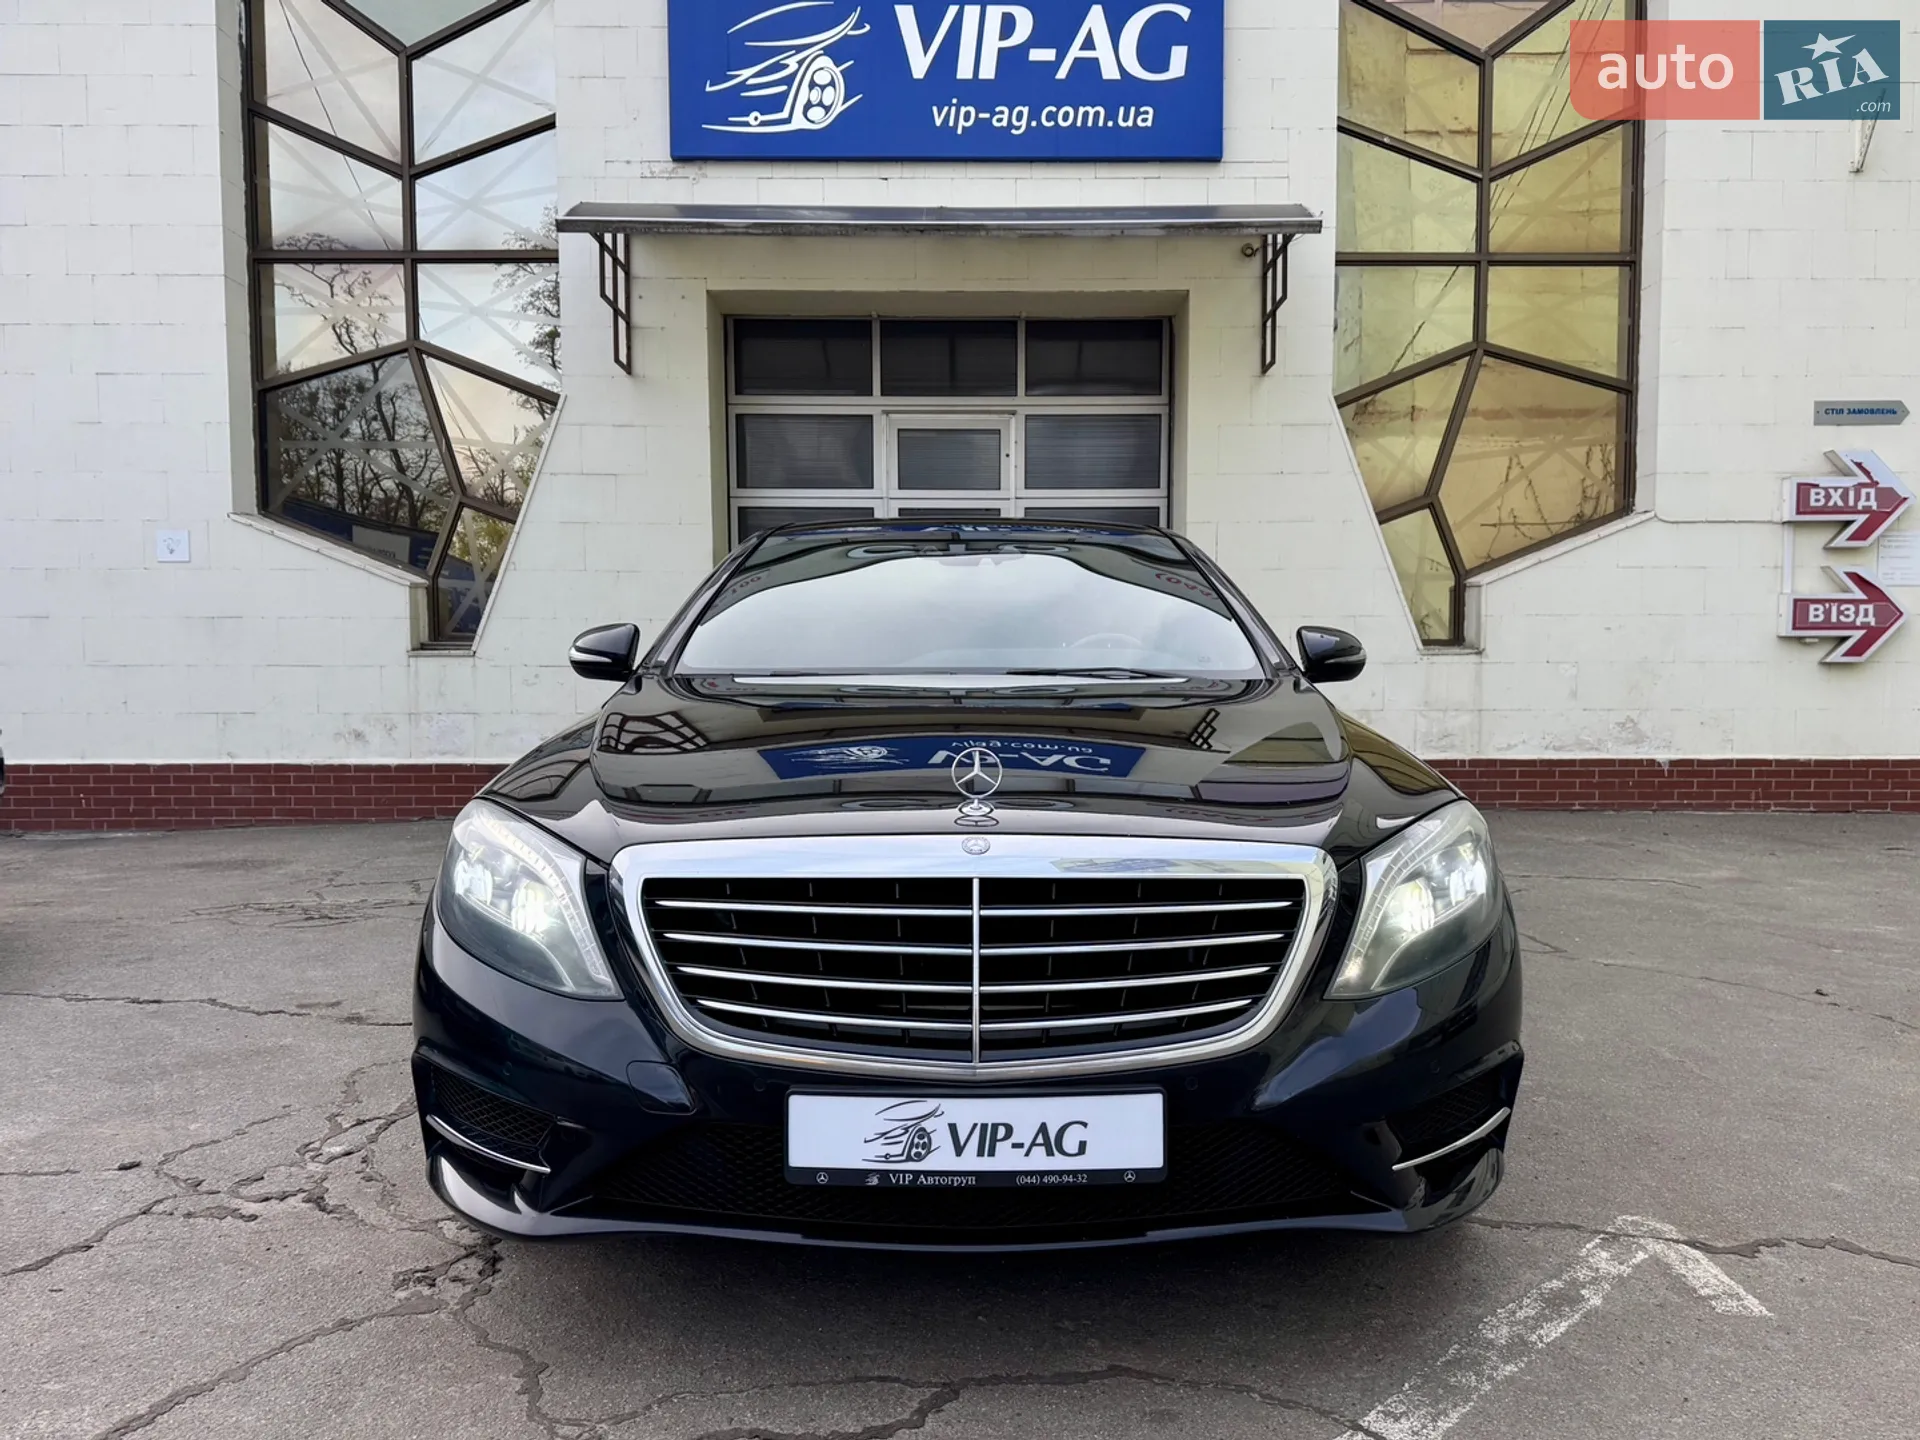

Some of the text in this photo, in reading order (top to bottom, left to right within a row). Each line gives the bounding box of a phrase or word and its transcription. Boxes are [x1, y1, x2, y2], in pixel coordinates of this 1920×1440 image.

[894, 2, 1192, 81] VIP-AG
[932, 98, 1154, 134] vip-ag.com.ua
[1824, 407, 1898, 416] СТІЛ ЗАМОВЛЕНЬ
[1809, 487, 1877, 511] ВХІД
[947, 1120, 1088, 1158] VIP-AG
[889, 1173, 976, 1187] VIP Автогруп
[1016, 1173, 1088, 1186] (044) 490-94-32
